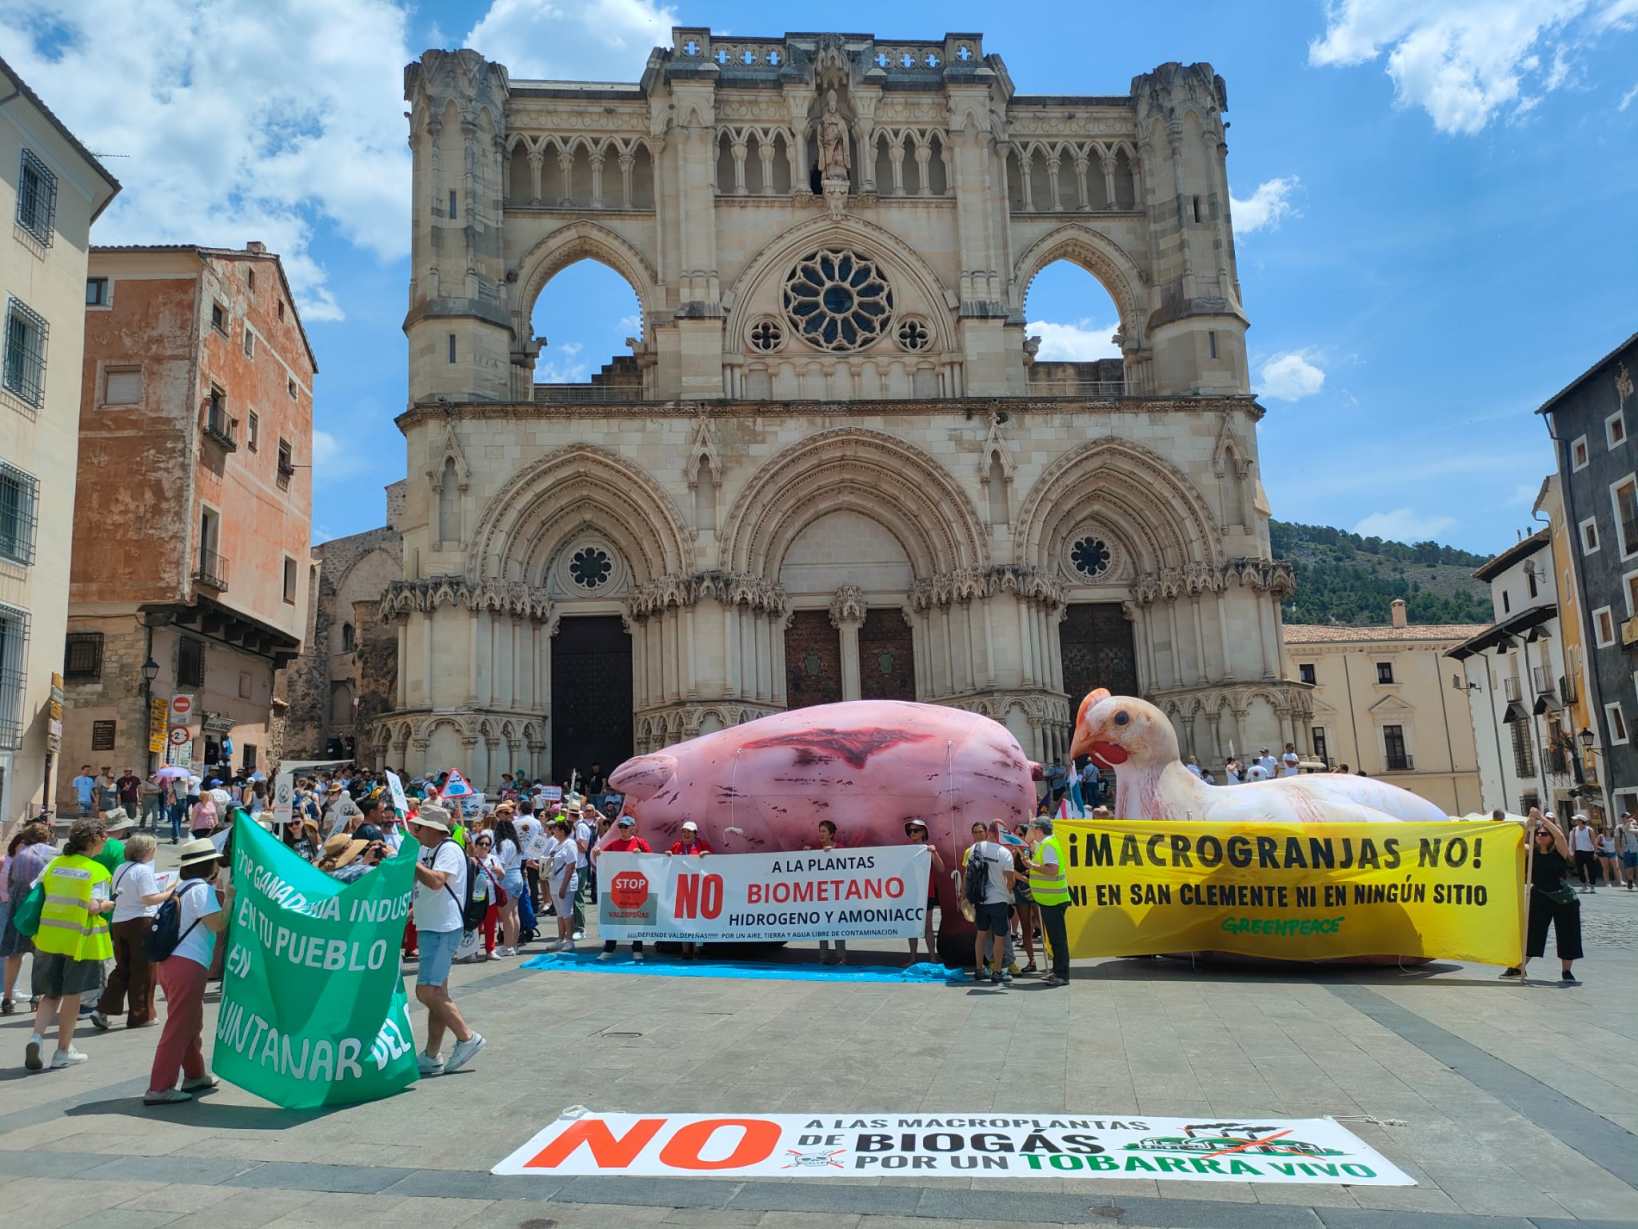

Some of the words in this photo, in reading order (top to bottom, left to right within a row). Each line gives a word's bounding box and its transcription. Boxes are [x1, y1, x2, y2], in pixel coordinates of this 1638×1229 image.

[772, 861, 782, 873] A
[786, 859, 804, 872] LA
[808, 856, 875, 872] PLANTAS
[1418, 837, 1483, 869] NO!
[615, 878, 646, 889] STOP
[674, 873, 724, 920] NO
[747, 876, 905, 904] BIOMETANO
[1068, 885, 1087, 906] NI
[1097, 884, 1121, 905] EN
[1130, 883, 1171, 906] SAN
[1180, 882, 1288, 907] CLEMENTE
[1296, 885, 1316, 907] NI
[1324, 885, 1347, 907] EN
[1354, 874, 1426, 905] NINGÚN
[1433, 884, 1487, 906] SITIO
[729, 911, 821, 926] HIDROGENO
[825, 911, 834, 924] Y
[1221, 916, 1345, 936] GREENPEACE
[258, 911, 273, 949] TU
[275, 926, 388, 971] PUEBLO
[218, 995, 363, 1081] UINTANAR
[803, 1119, 824, 1129] A
[834, 1119, 889, 1129] LAS
[897, 1118, 1151, 1131] MACROPLANTAS
[522, 1118, 783, 1170] NO
[798, 1134, 845, 1146] DE
[855, 1129, 1105, 1154] BIOGÁS
[855, 1155, 937, 1169] POR
[950, 1155, 1009, 1170] UN
[1019, 1153, 1264, 1176] TOBARRA
[1267, 1161, 1377, 1178] VIVO
